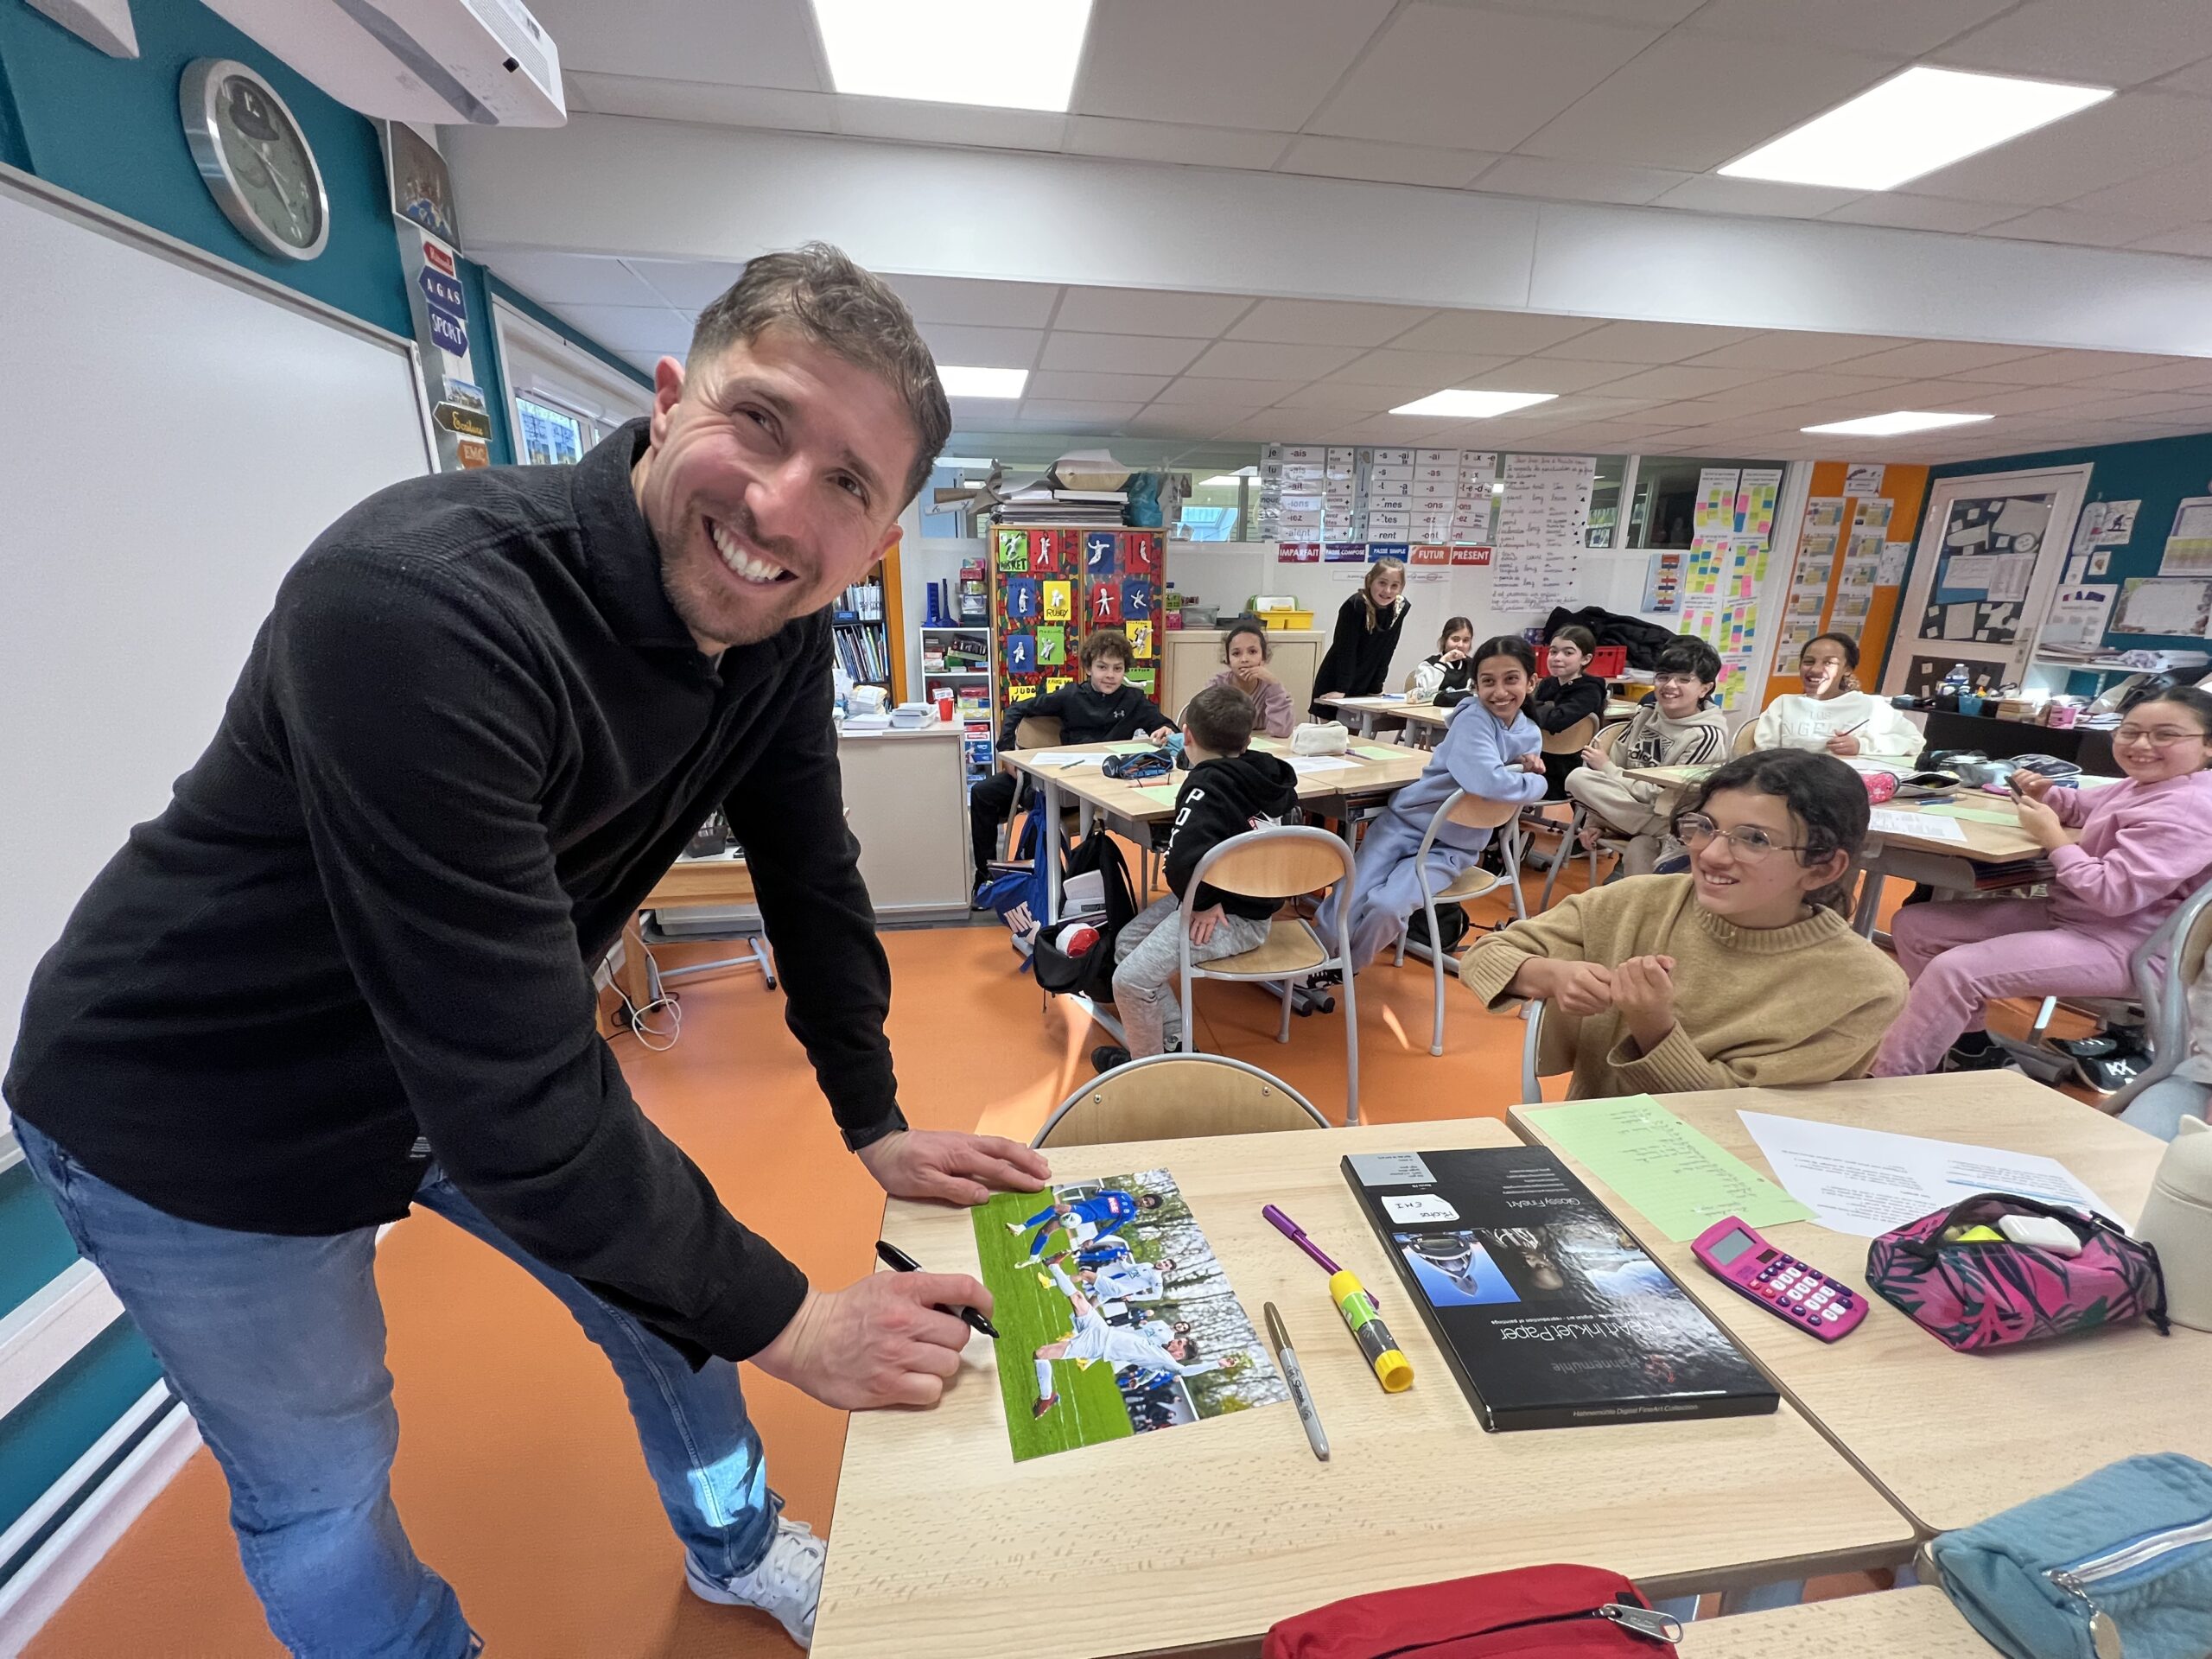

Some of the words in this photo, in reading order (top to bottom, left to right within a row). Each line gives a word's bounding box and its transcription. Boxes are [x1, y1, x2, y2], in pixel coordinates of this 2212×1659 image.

[431, 313, 462, 345] SPORT
[1268, 449, 1277, 458] je
[1279, 548, 1319, 556] IMPARFAIT
[1418, 549, 1445, 560] FUTUR
[1452, 548, 1490, 561] PRÉSENT
[1505, 1199, 1546, 1209] FineArt
[1544, 1197, 1581, 1207] Glossy
[1551, 1321, 1607, 1340] InkJet
[1603, 1317, 1670, 1336] FineArt
[1499, 1324, 1554, 1342] Paper
